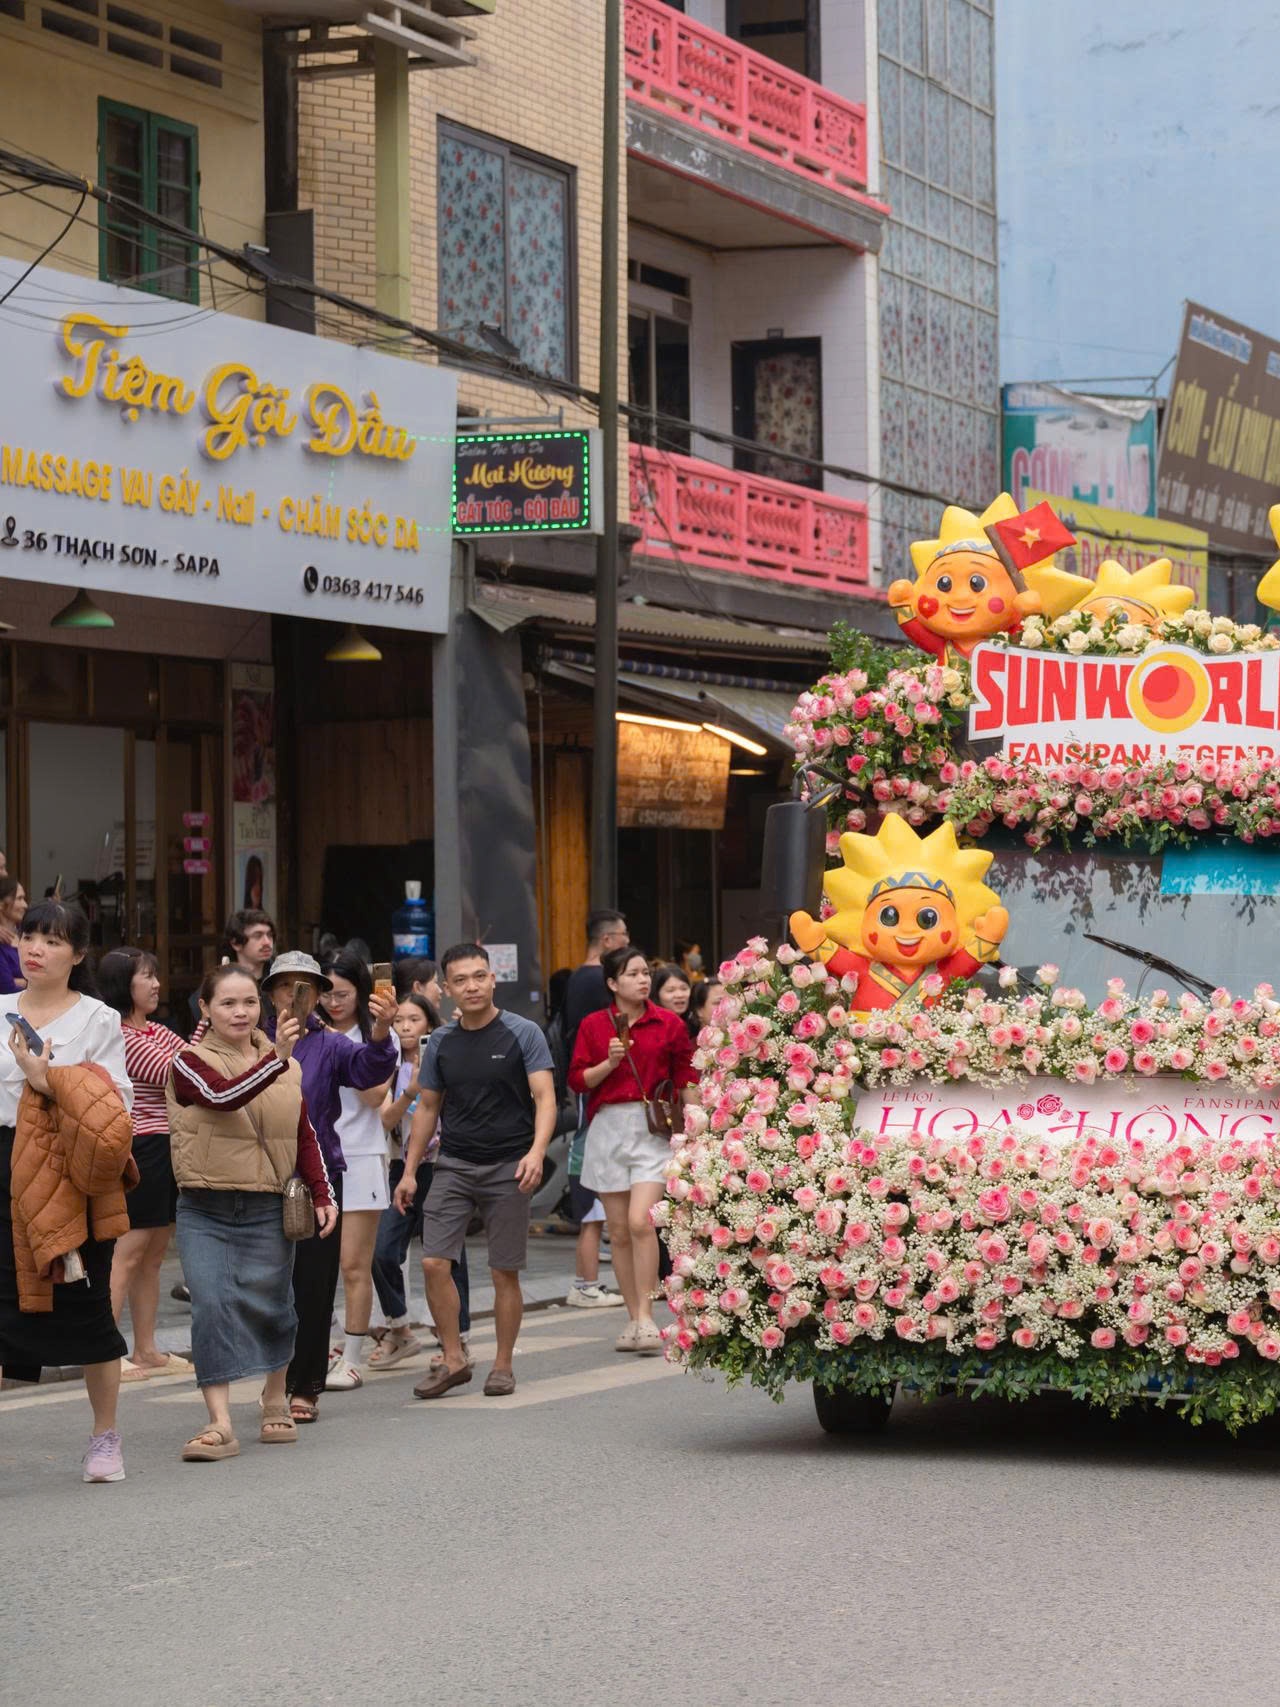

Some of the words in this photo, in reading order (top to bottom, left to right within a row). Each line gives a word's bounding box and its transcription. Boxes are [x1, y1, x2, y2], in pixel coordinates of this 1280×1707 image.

[60, 312, 195, 422] Tiệm
[201, 362, 297, 460] Gội
[306, 383, 418, 460] Đầu
[463, 461, 506, 489] Mai
[507, 456, 575, 491] Hương
[1, 446, 113, 502] MASSAGE
[120, 465, 153, 508] VAI
[159, 466, 201, 517] GÁY
[217, 484, 256, 527] Nail
[278, 493, 341, 540] CHĂM
[346, 497, 388, 547] SÓC
[393, 515, 420, 553] DA
[457, 494, 483, 524] CẮT
[485, 495, 513, 523] TÓC
[523, 494, 548, 524] GỘI
[551, 490, 580, 520] ĐẦU
[23, 530, 48, 552] 36
[54, 534, 115, 566] THẠCH
[120, 545, 157, 568] SƠN
[174, 553, 220, 577] SAPA
[322, 575, 360, 598] 0363
[365, 580, 392, 602] 417
[396, 584, 424, 606] 546
